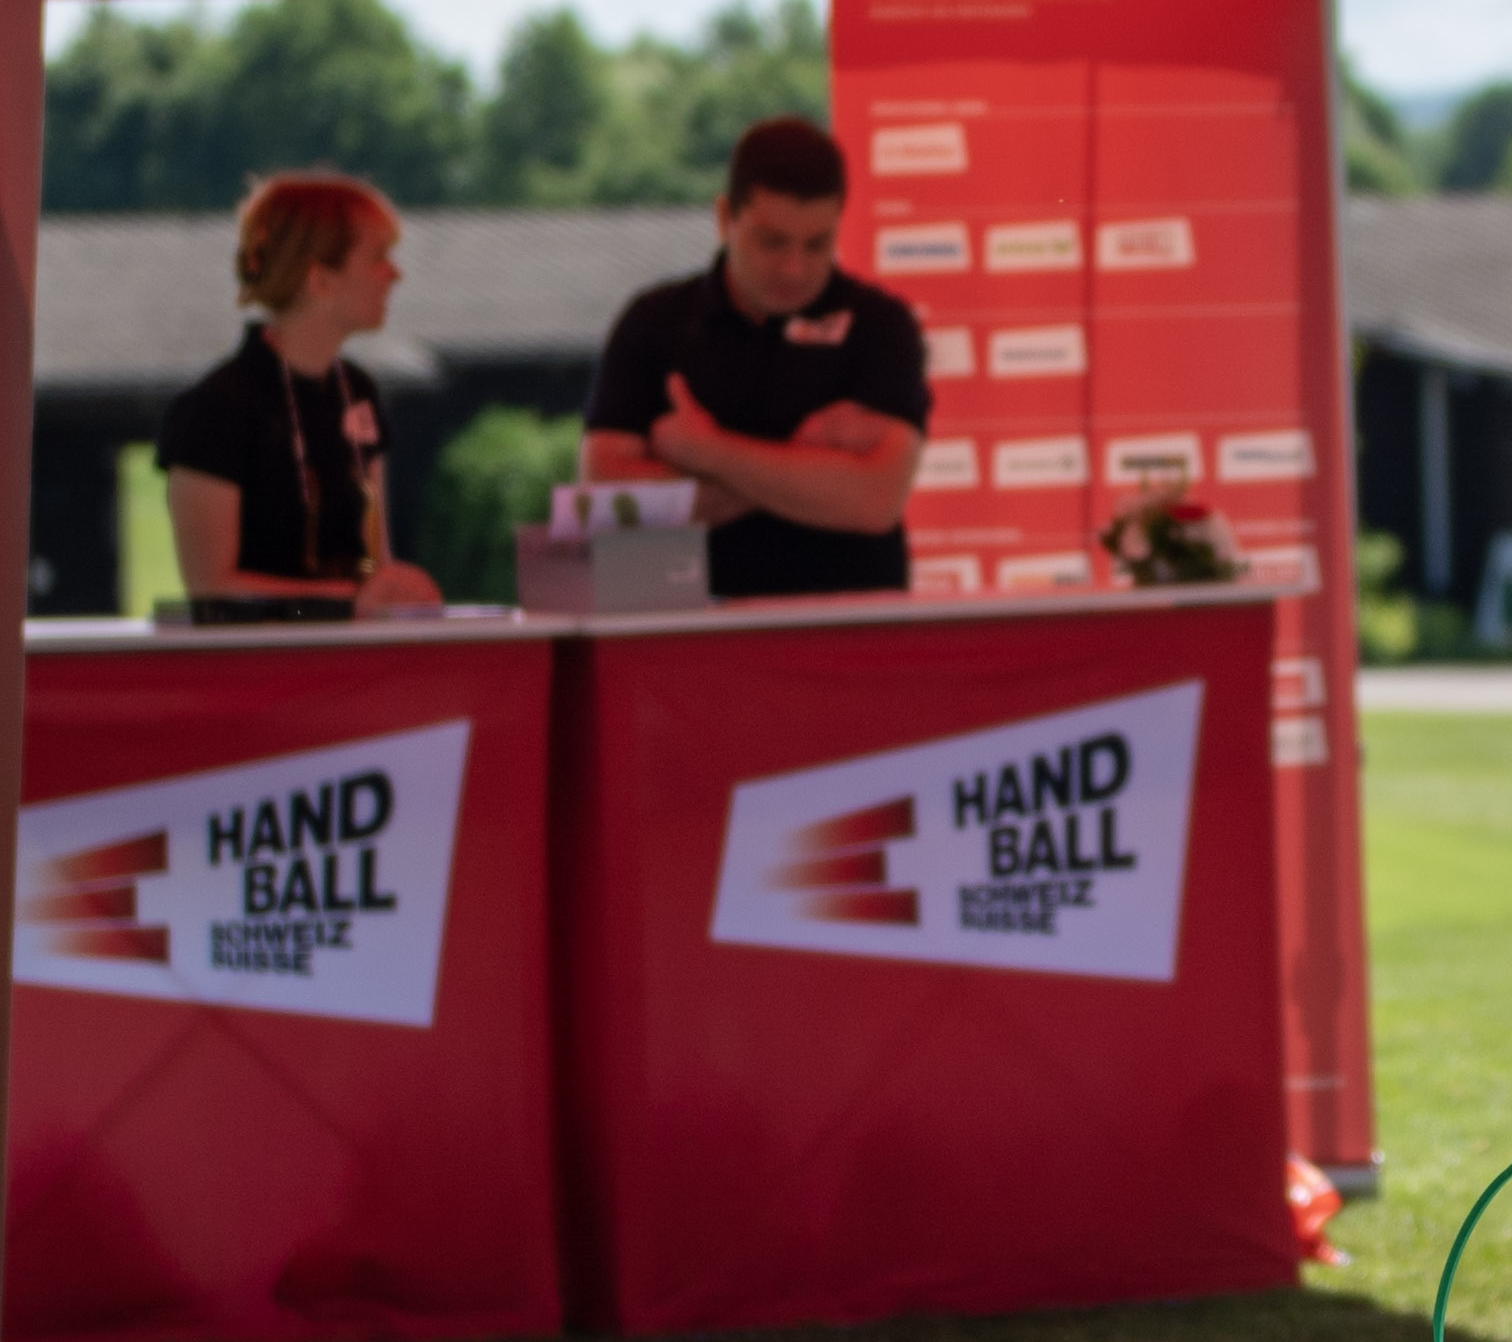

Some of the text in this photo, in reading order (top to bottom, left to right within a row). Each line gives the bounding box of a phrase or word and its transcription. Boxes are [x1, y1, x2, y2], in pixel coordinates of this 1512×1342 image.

[954, 731, 1131, 829] HAND
[208, 768, 394, 868] HAND
[991, 807, 1137, 876] BALL
[244, 846, 397, 914] BALL
[210, 918, 353, 950] SCHWEIZ
